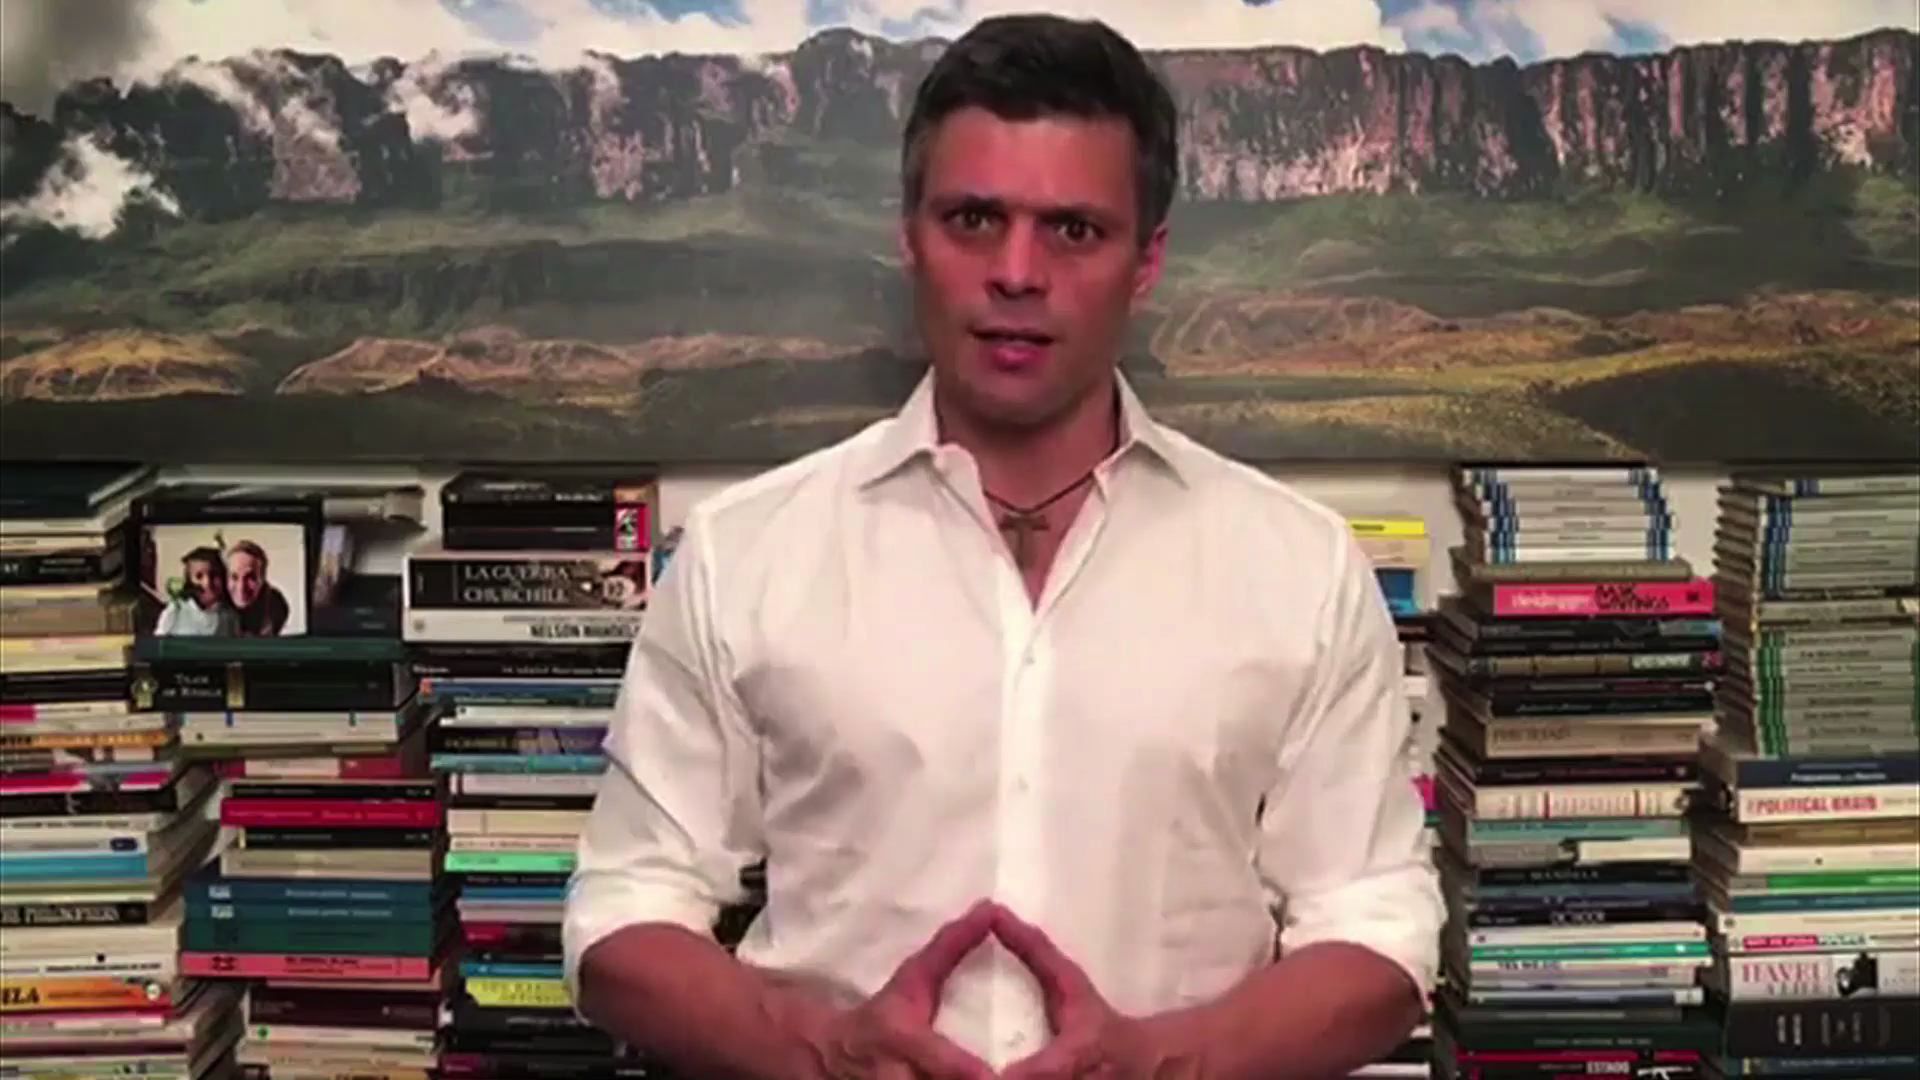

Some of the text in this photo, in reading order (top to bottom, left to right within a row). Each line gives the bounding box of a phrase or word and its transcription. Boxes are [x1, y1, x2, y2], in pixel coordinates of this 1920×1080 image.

[464, 564, 490, 579] LA
[463, 589, 567, 603] CHURCHILL
[528, 624, 580, 638] NELSON
[1756, 797, 1827, 815] POLITICAL
